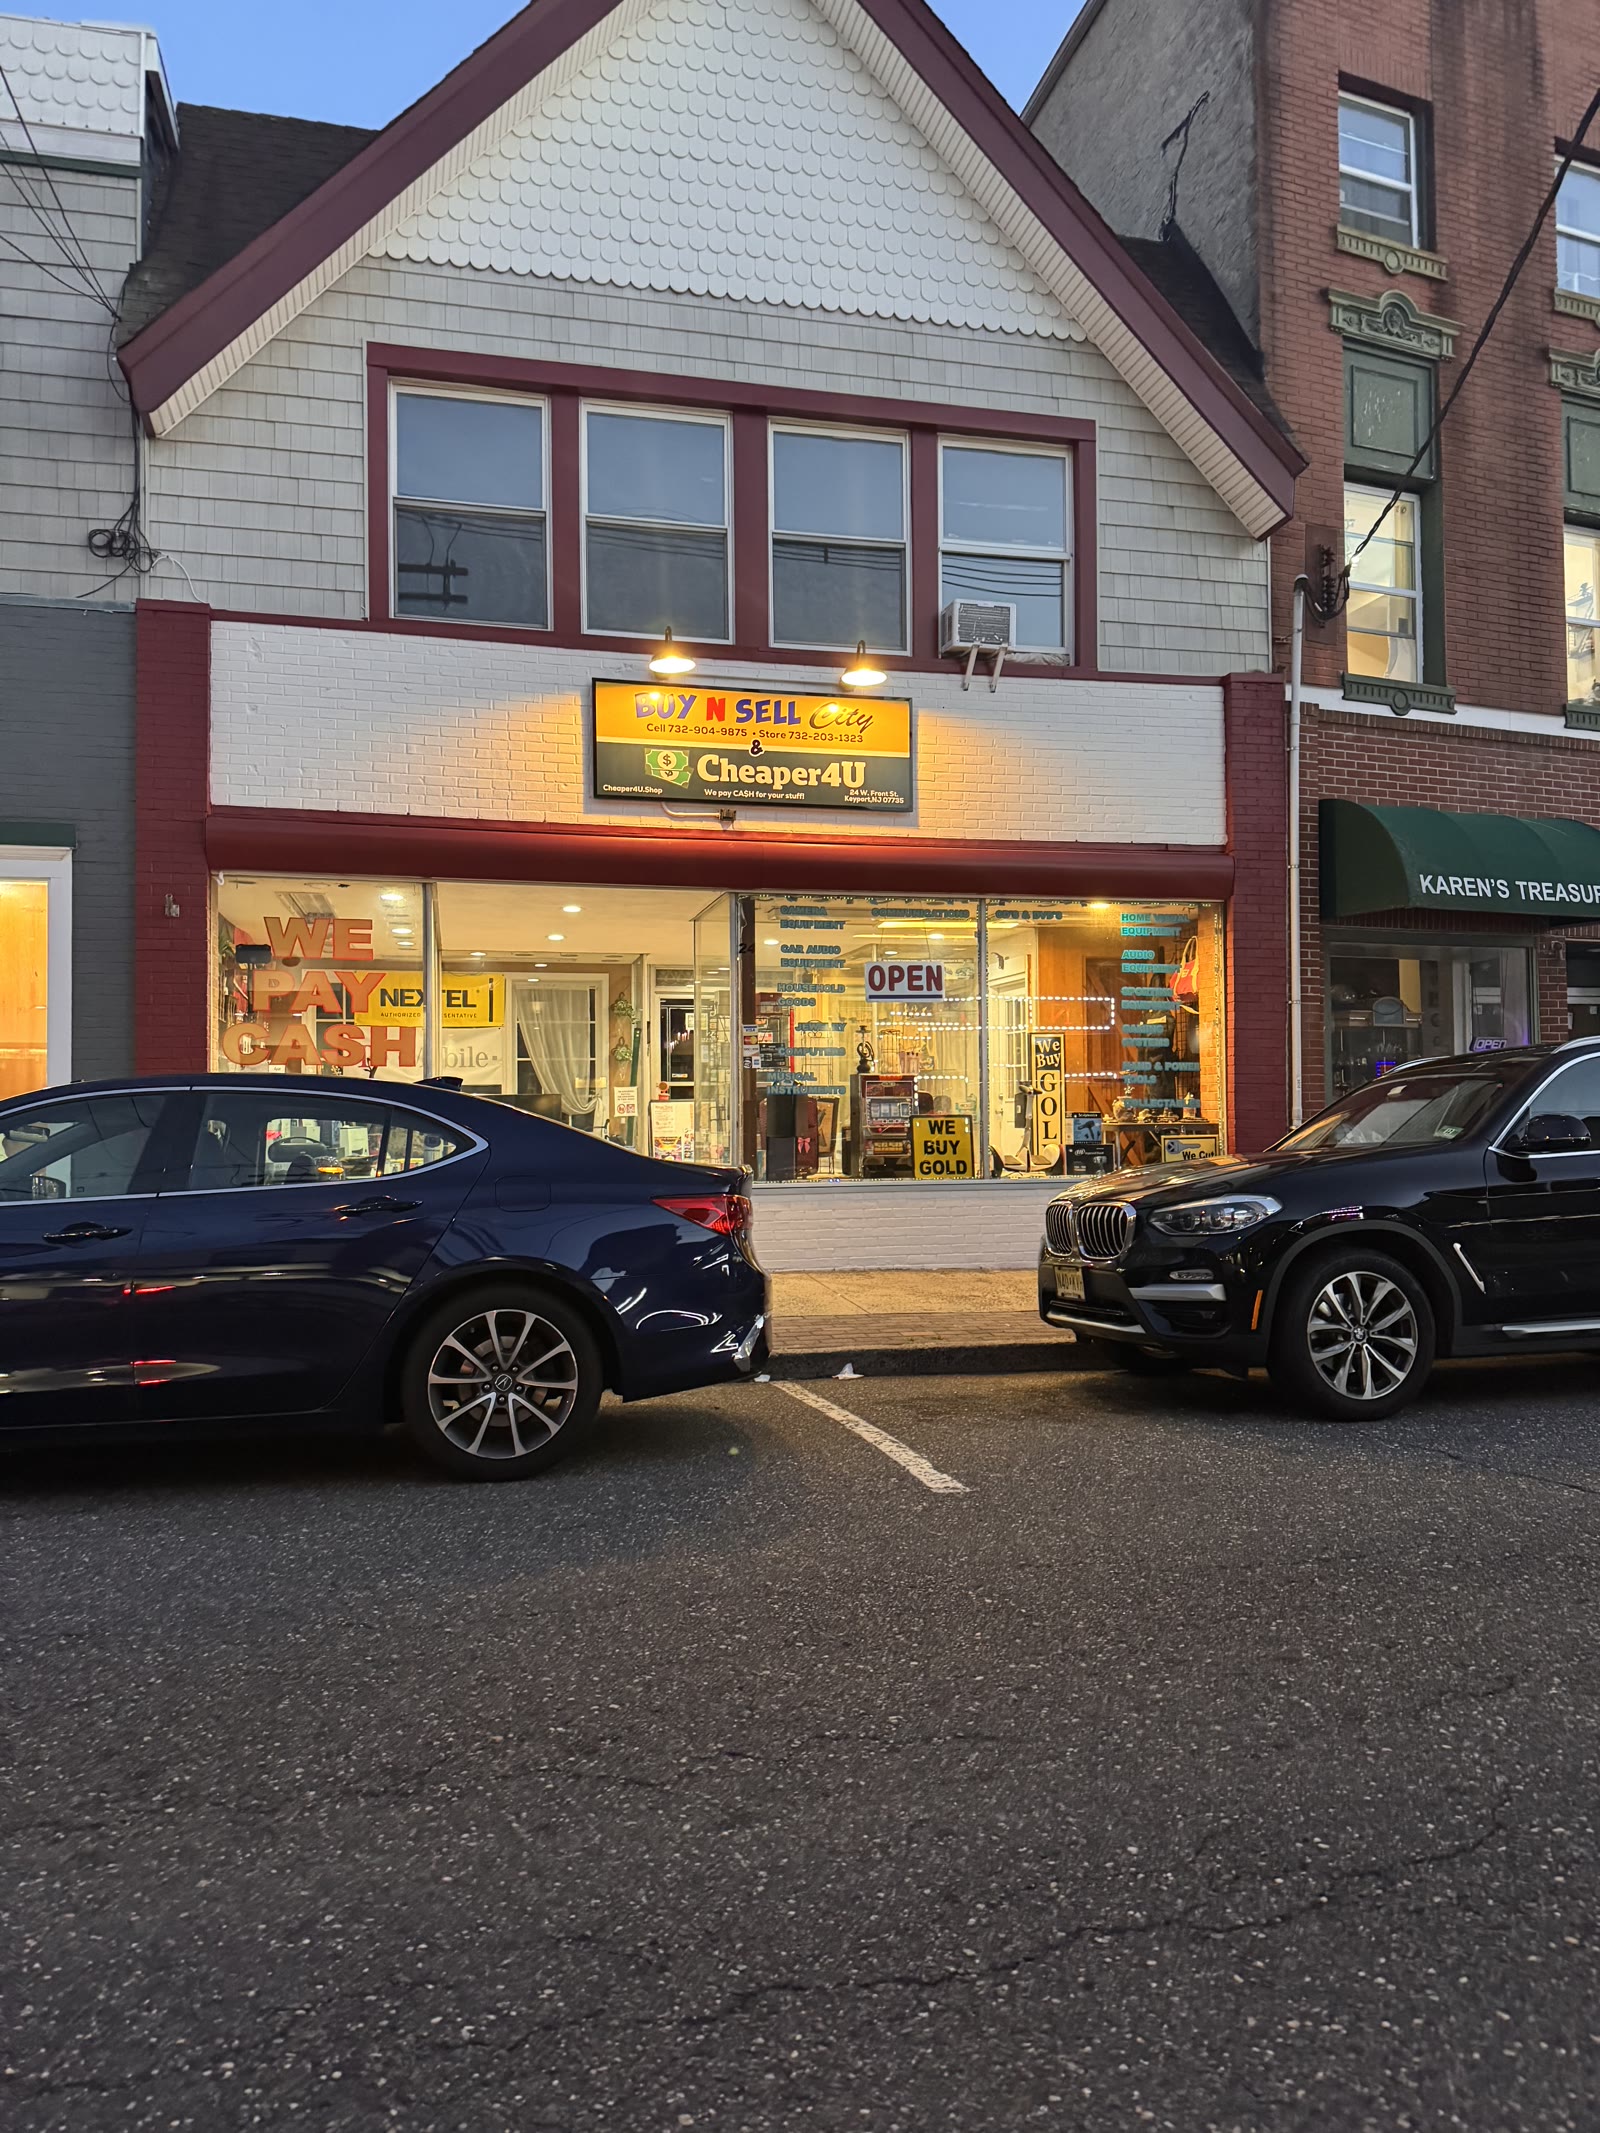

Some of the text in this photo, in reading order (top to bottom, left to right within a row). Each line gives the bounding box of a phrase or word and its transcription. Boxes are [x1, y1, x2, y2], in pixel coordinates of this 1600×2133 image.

[634, 692, 874, 734] BUY N SELL City
[646, 723, 863, 743] Cell 732-904-9875 Store 732-203-1323
[750, 739, 764, 757] &
[696, 754, 867, 790] Cheaper4U
[602, 784, 663, 795] Cheaper4U.Shop
[704, 788, 717, 796] We
[717, 789, 732, 798] pay
[767, 792, 785, 800] your
[785, 792, 805, 800] stuff!
[1419, 874, 1510, 899] KAREN'S
[780, 904, 828, 916] CAMERA
[780, 919, 846, 930] EQUIPMENT
[1121, 913, 1152, 924] HOME
[1121, 926, 1182, 937] EQUIPMENT
[263, 916, 374, 961] WE
[780, 944, 842, 955] CAR AUDIO
[1121, 949, 1156, 960] AUDIO
[780, 958, 846, 969] EQUIPMENT
[867, 964, 943, 992] OPEN
[253, 970, 387, 1013] PAY
[777, 982, 846, 994] HOUSEHOLD
[380, 988, 477, 1008] NEXEL
[777, 996, 817, 1007] GOODS
[222, 1023, 417, 1068] CASH
[1036, 1039, 1061, 1055] We
[1476, 1039, 1507, 1049] OPEN
[778, 1046, 847, 1057] COMPUTERS
[1036, 1052, 1061, 1069] Buy
[1153, 1061, 1163, 1071] &
[1164, 1062, 1200, 1072] POWER
[767, 1071, 818, 1082] MUSICAL
[1122, 1074, 1157, 1084] TOOLS
[766, 1085, 847, 1095] INSTRUMENTS
[1123, 1098, 1201, 1108] COLLECTABES
[1039, 1072, 1058, 1149] GOL
[927, 1120, 955, 1135] WE
[923, 1140, 960, 1155] BUY
[1182, 1151, 1196, 1160] We
[919, 1160, 968, 1175] GOLD
